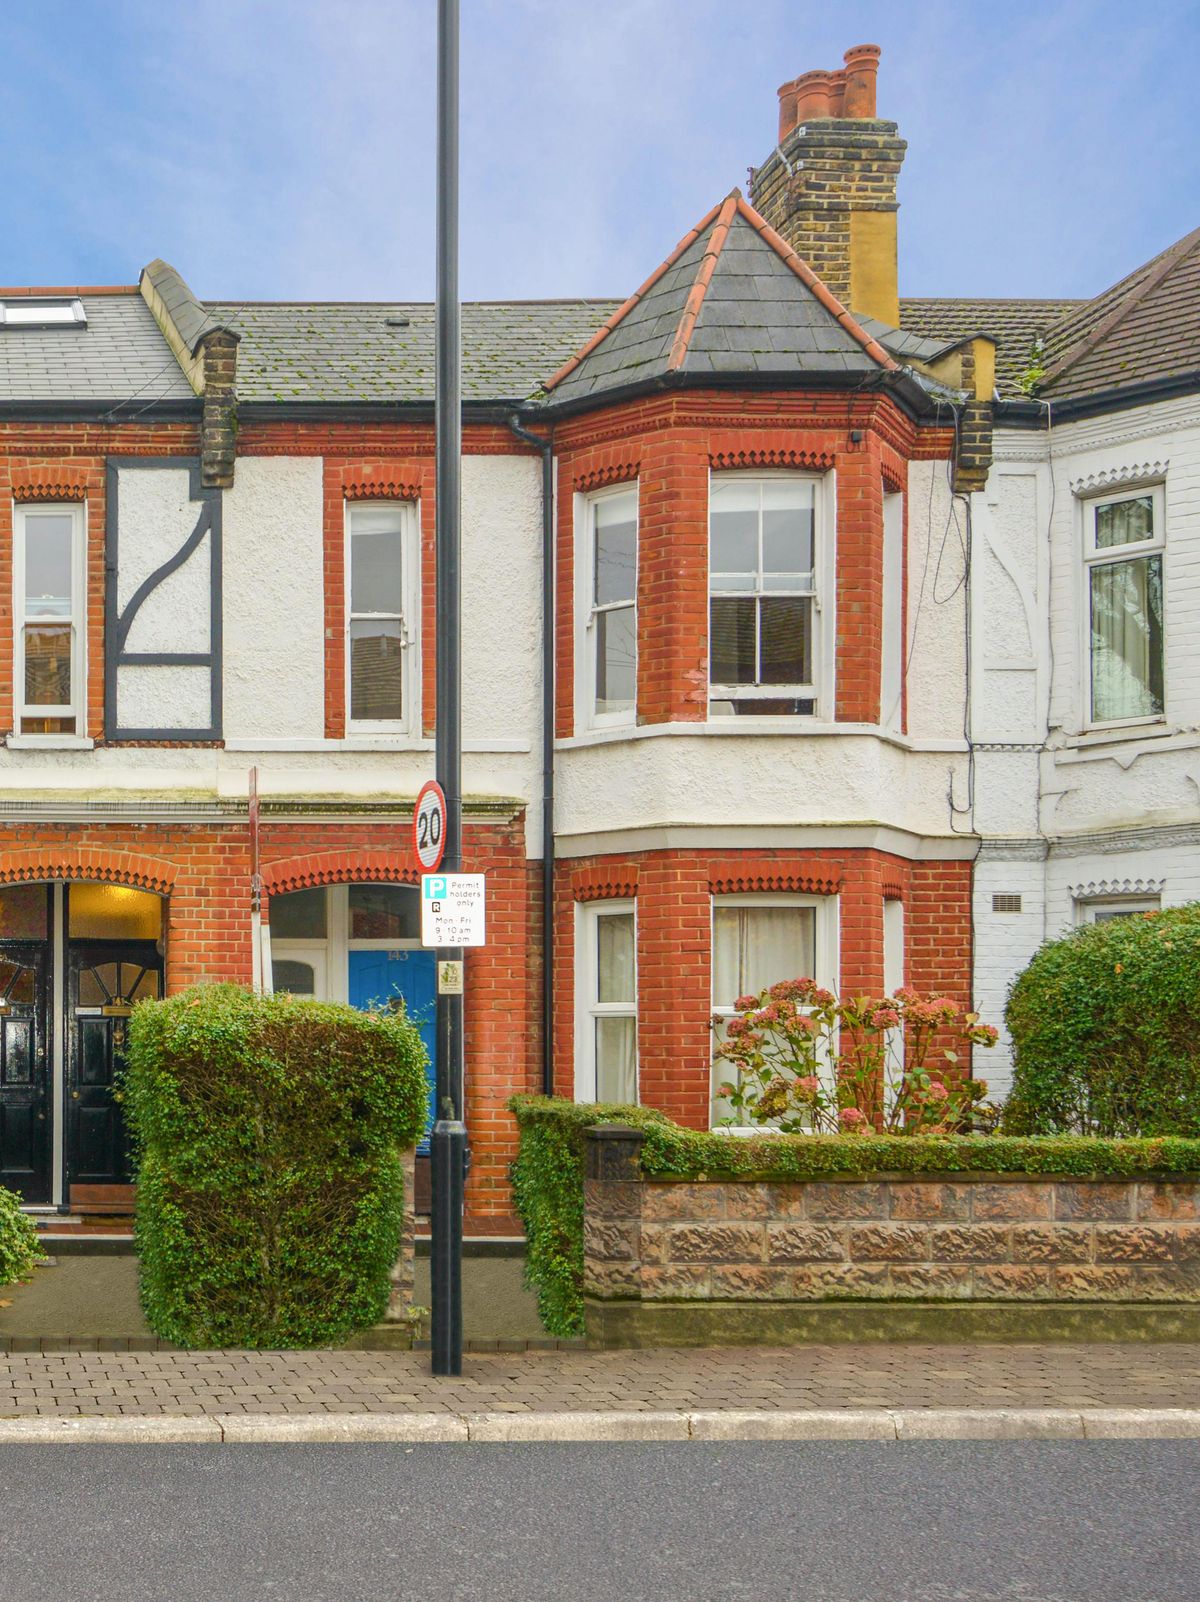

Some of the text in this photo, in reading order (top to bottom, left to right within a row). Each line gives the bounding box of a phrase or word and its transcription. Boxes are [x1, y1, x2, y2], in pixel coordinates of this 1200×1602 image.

[419, 807, 440, 850] 20
[430, 878, 445, 898] P
[451, 881, 480, 889] Permit
[432, 902, 441, 912] R
[460, 916, 472, 924] Fri
[435, 926, 441, 934] 9
